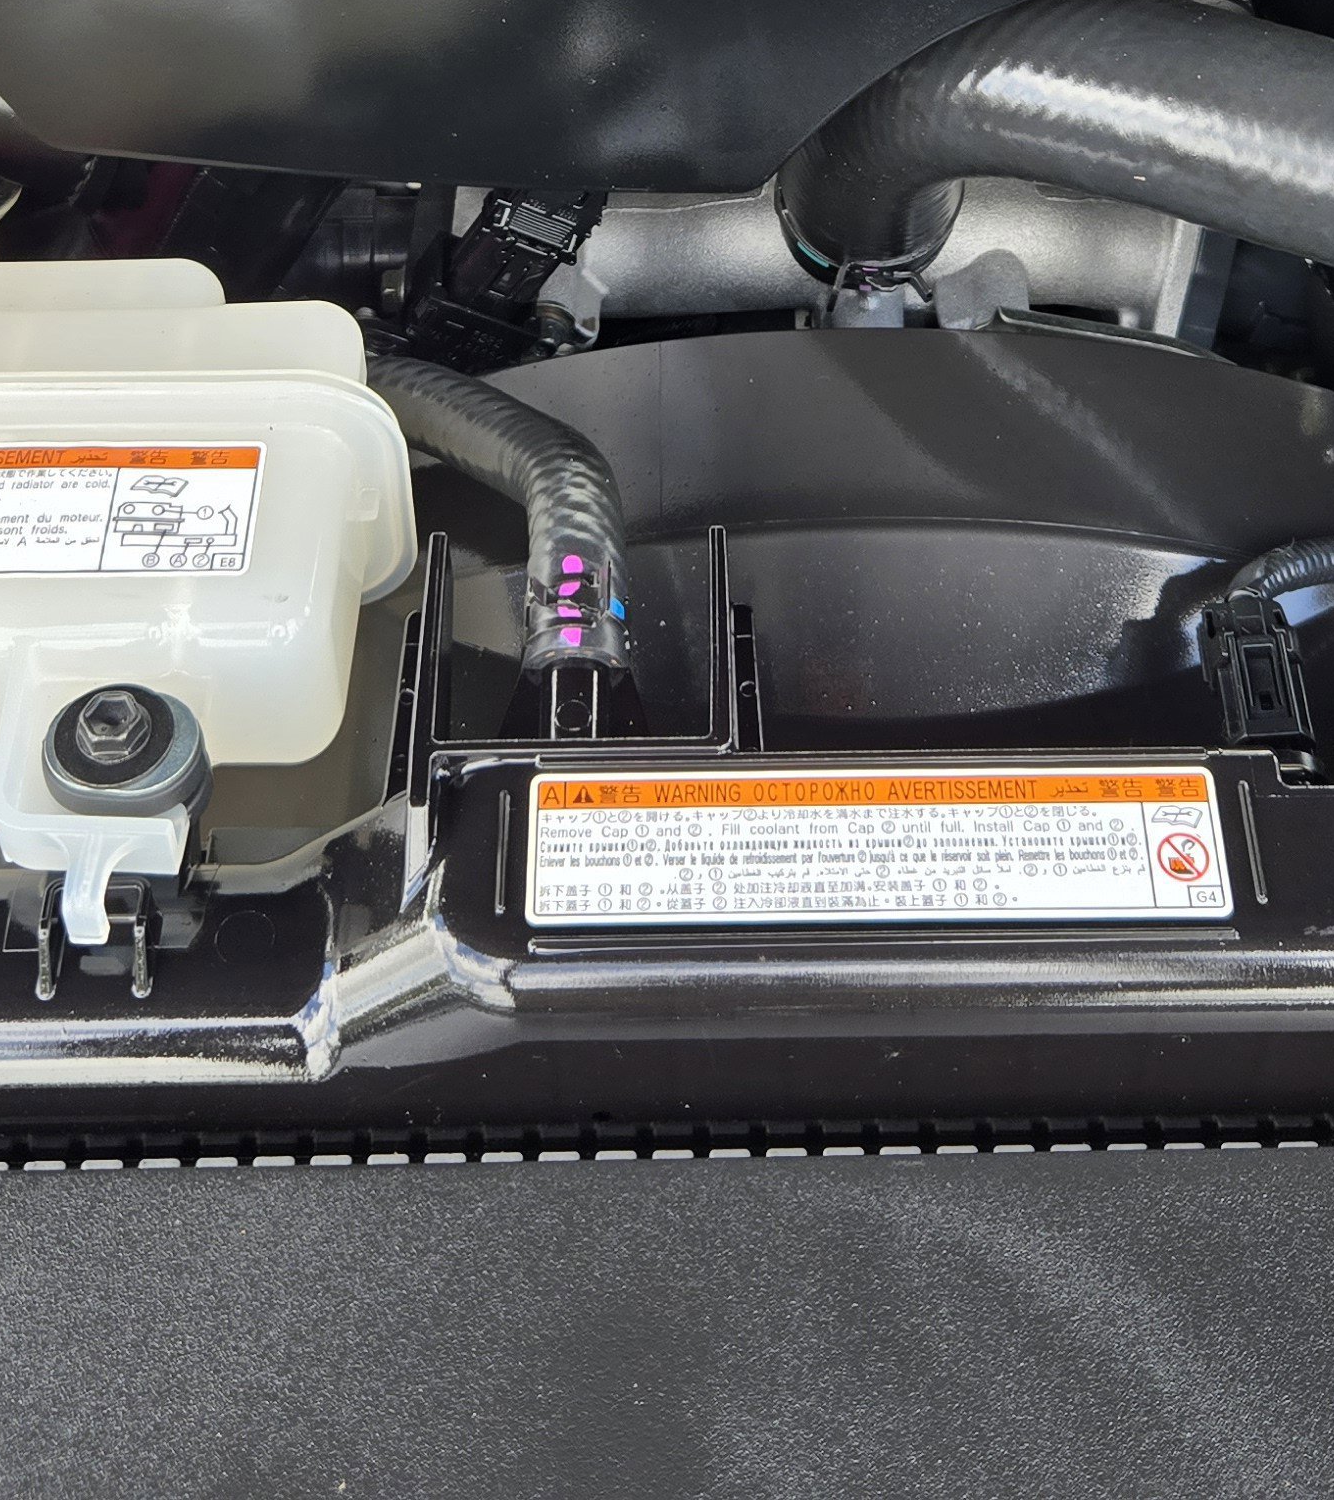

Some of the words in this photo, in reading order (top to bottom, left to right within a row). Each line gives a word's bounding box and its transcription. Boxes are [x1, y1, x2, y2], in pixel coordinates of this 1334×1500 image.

[129, 450, 167, 464] 警告
[190, 450, 229, 465] 警告
[11, 480, 54, 489] radiator
[61, 480, 78, 488] are
[85, 480, 110, 488] cold.
[37, 513, 52, 523] du
[59, 513, 103, 522] moteur.
[30, 525, 67, 535] froids.
[220, 557, 236, 567] E8
[542, 786, 560, 805] A
[599, 785, 641, 803] 警告
[654, 783, 742, 803] WARNING
[754, 781, 875, 802] ОСТОРОЖНО
[887, 779, 1037, 801] AVERTISSEMENT
[1050, 779, 1089, 797] تحذير
[1099, 778, 1142, 797] 警告
[1155, 778, 1199, 797] 警告
[540, 827, 592, 838] Remove
[601, 825, 628, 839] Cap
[656, 825, 681, 837] and
[722, 823, 741, 835] Fill
[750, 823, 799, 835] coolant
[809, 822, 838, 834] from
[848, 822, 875, 835] Cap
[902, 821, 931, 833] until
[941, 821, 964, 833] full.
[974, 820, 1014, 832] Install
[1023, 820, 1050, 832] Cap
[1078, 820, 1103, 831] and
[1196, 891, 1216, 902] G4
